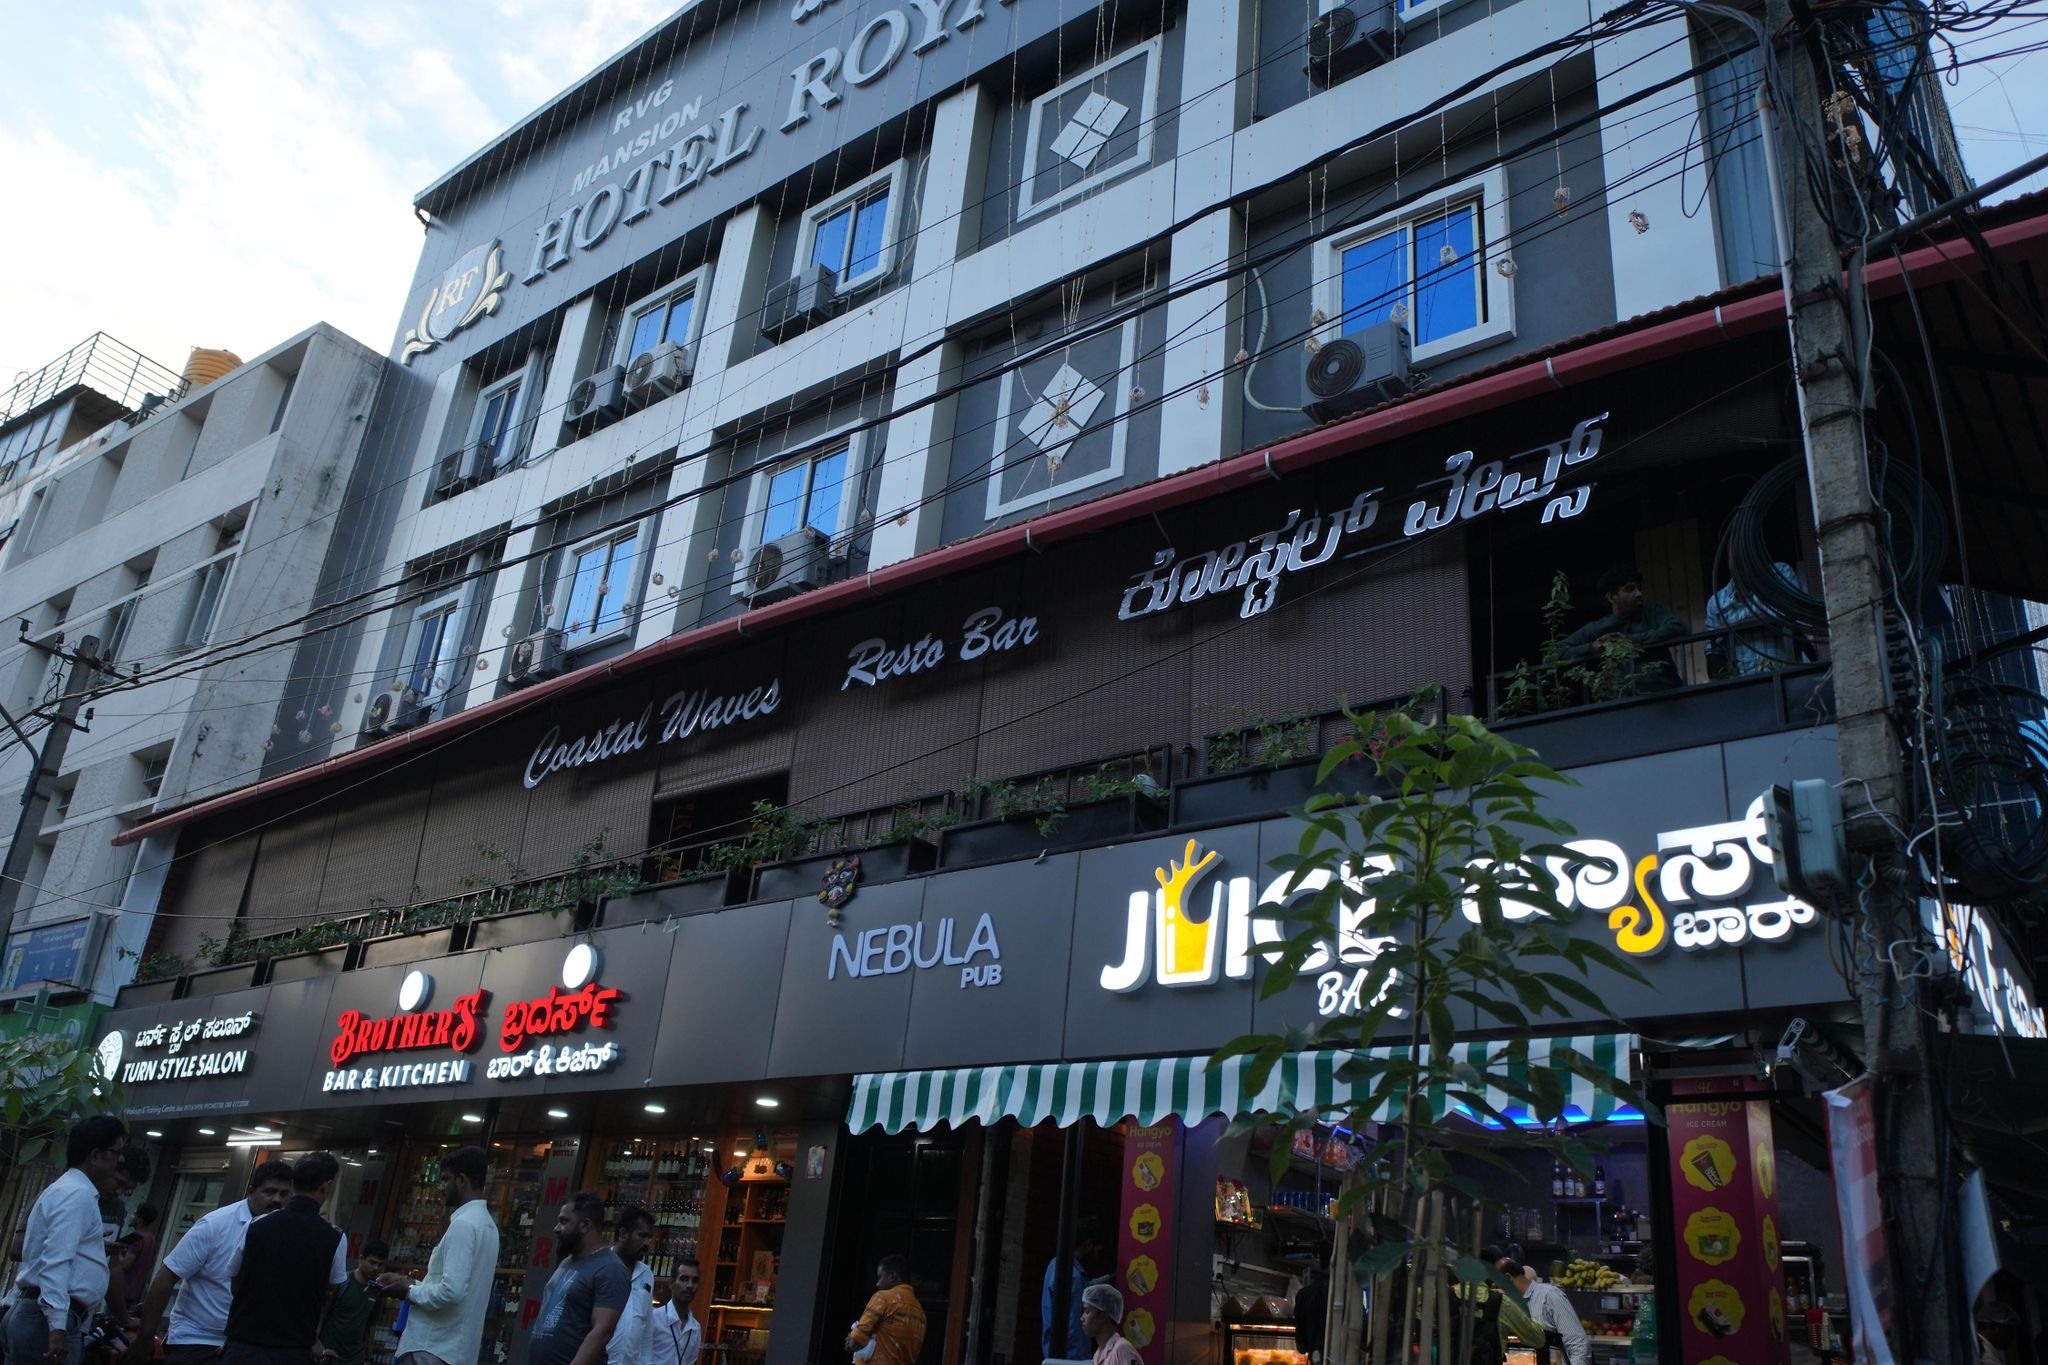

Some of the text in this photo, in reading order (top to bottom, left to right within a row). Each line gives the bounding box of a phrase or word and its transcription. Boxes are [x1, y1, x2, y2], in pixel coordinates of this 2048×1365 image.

[612, 79, 674, 134] RVG
[569, 96, 702, 196] MANSION
[522, 102, 763, 286] HOTEL
[1117, 486, 1386, 622] ಕೋಸ್ಟಲ್
[523, 606, 1039, 790] Coastal Waves Resto Bar
[1100, 838, 1403, 993] JUICE
[1673, 895, 1820, 953] ಬಾರ್
[827, 912, 1000, 980] NEBULA
[960, 964, 1003, 989] PUB
[202, 1011, 253, 1040] ಸಲೂನ್
[499, 983, 623, 1053] ಬ್ರದರ್ಸ್
[122, 1050, 247, 1083] TURN STYLE SALON
[322, 1060, 471, 1093] BAR & KITCHEN
[487, 1041, 618, 1080] ಬಾರ್ & ಕಿಚನ್
[1701, 1120, 1728, 1128] CREAM
